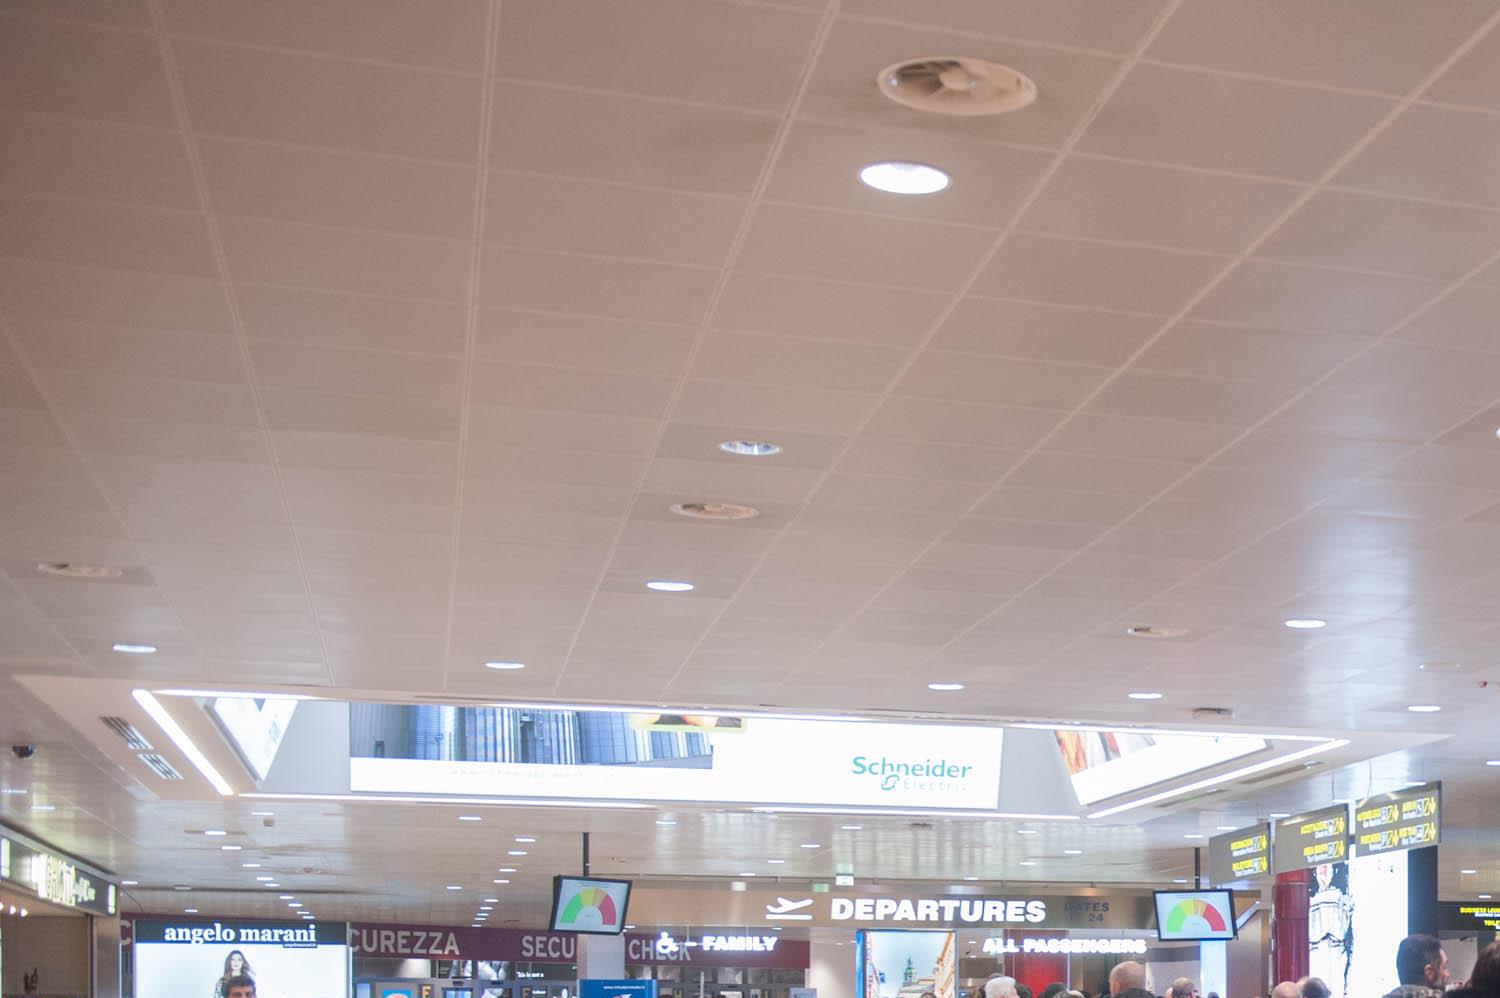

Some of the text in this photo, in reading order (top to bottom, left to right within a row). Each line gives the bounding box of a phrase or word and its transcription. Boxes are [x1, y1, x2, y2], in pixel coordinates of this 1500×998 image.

[852, 756, 973, 778] Schneider
[903, 779, 968, 791] Electric
[831, 898, 1046, 923] DEPARTURES
[165, 922, 317, 944] angelo marani
[350, 929, 460, 956] CUREZZA
[521, 935, 575, 958] SECU
[702, 935, 778, 951] FAMILY
[982, 938, 1147, 954] ALL PASSENGERS
